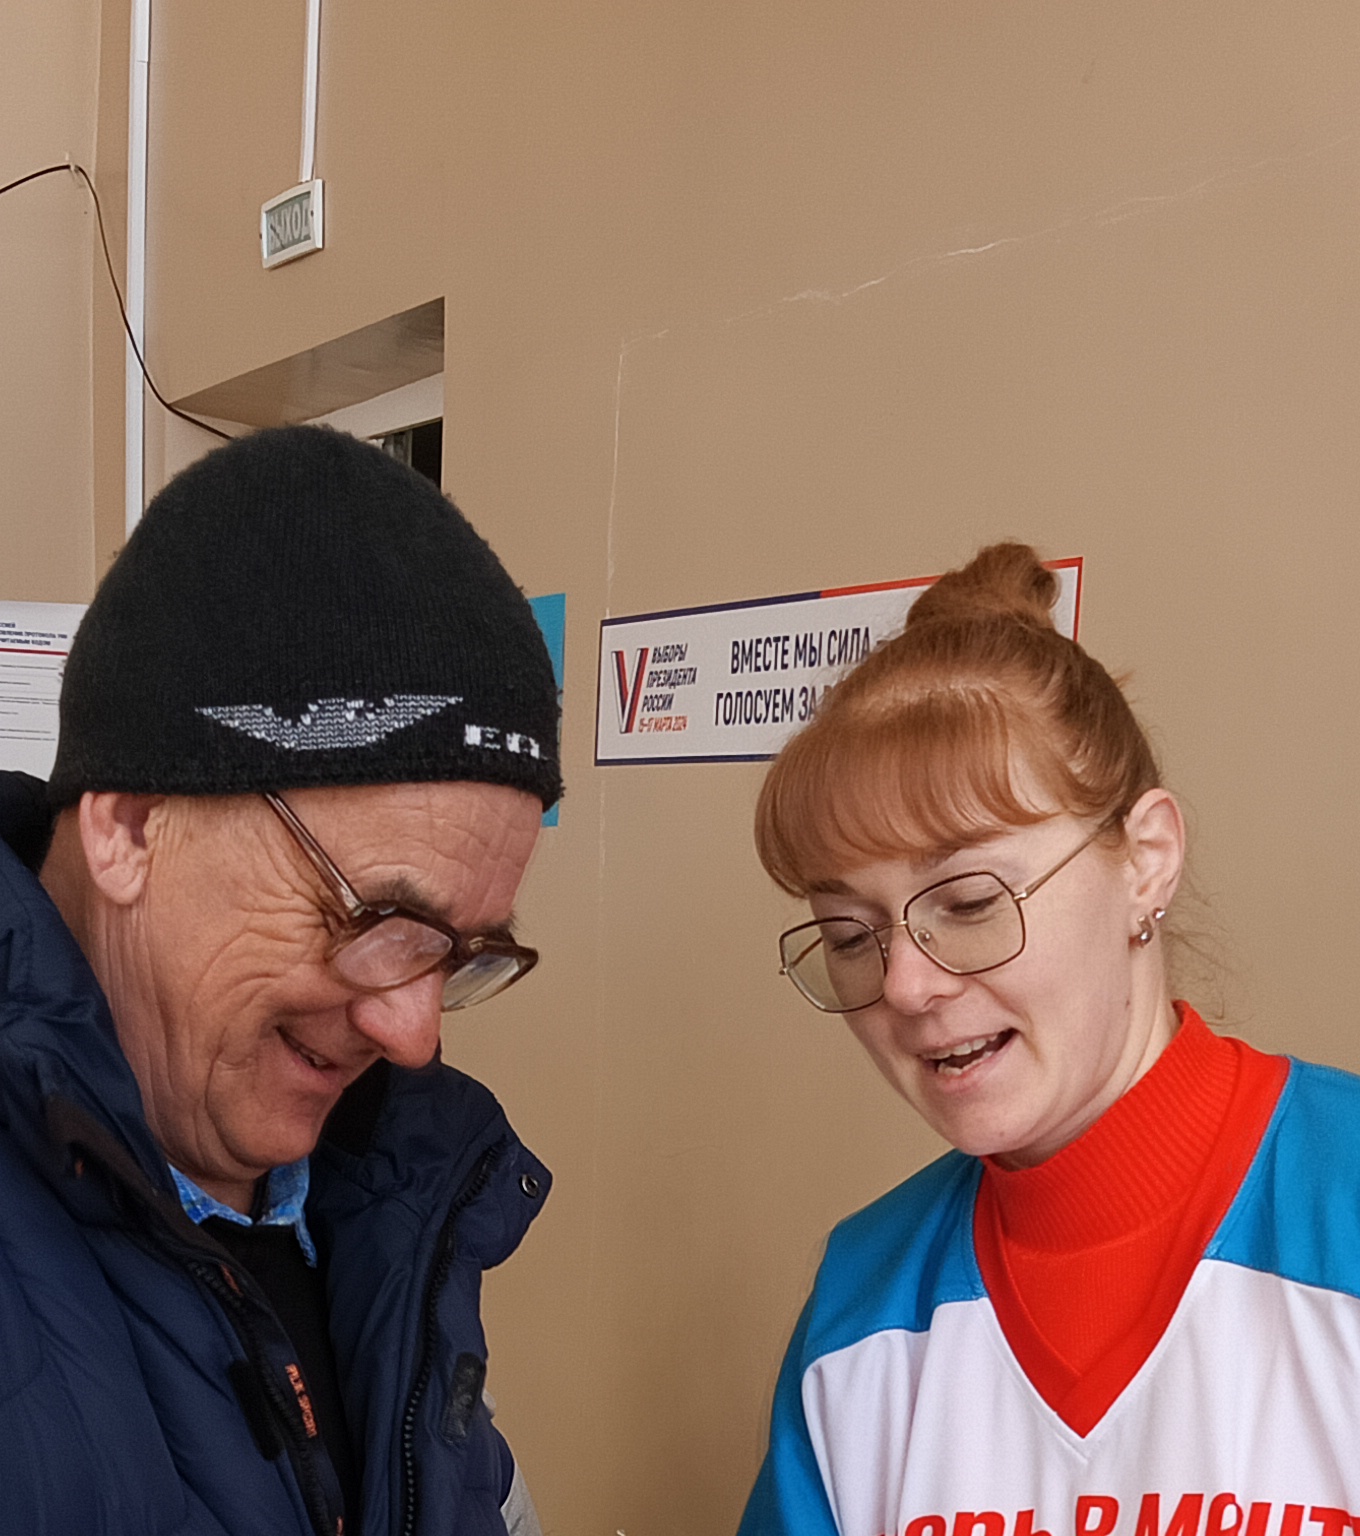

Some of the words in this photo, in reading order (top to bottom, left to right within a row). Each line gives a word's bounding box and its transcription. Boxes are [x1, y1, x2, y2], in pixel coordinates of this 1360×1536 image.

[651, 643, 688, 664] ВЫБОРЫ
[731, 635, 790, 674] ВМЕСТЕ
[793, 631, 823, 668] МЫ
[827, 626, 870, 667] СИЛА
[646, 667, 697, 689] ПРЕЗИДЕНТА
[641, 693, 674, 712] РОССИИ
[715, 687, 794, 726] ГОЛОСУЕМ
[798, 686, 817, 722] ЗА
